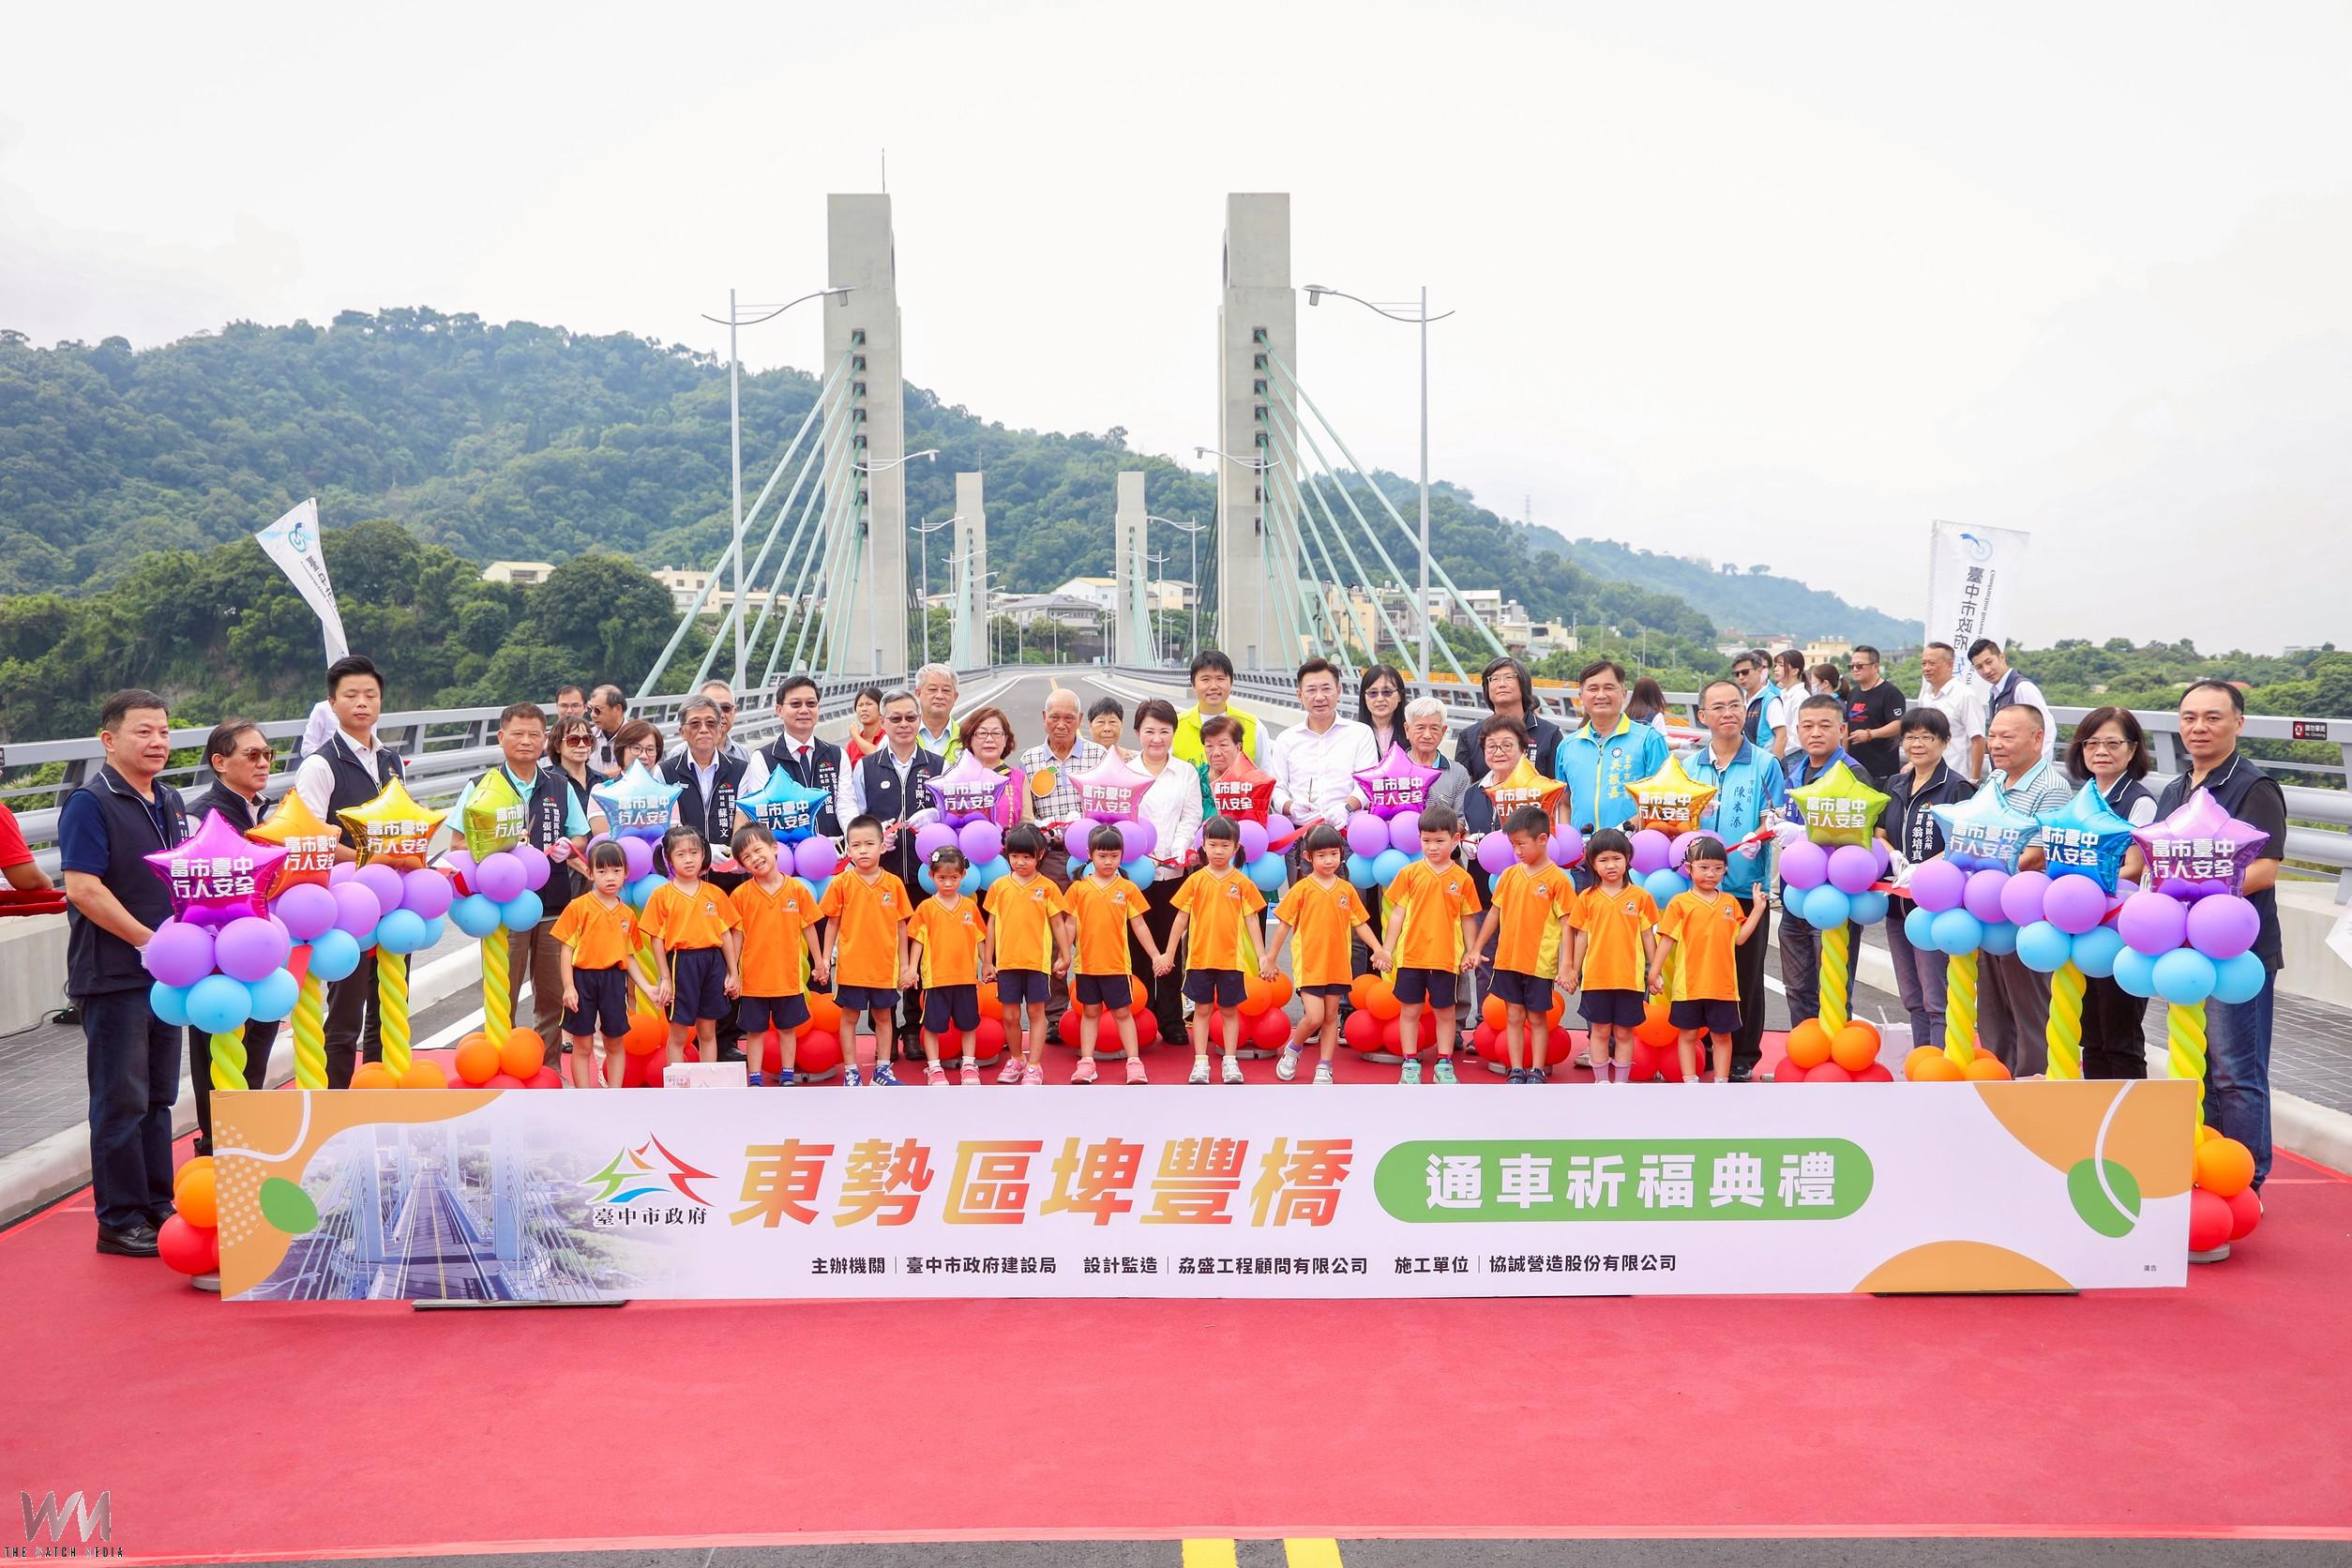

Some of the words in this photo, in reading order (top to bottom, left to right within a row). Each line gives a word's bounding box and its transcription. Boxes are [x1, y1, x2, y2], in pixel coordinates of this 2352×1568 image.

[943, 780, 995, 796] 富市臺中
[1082, 784, 1131, 798] 富市臺中
[1372, 776, 1423, 792] 富市臺中
[618, 795, 669, 809] 富市臺中
[943, 794, 995, 809] 行人安全
[1373, 791, 1423, 806] 行人安全
[1495, 788, 1542, 801] 富市臺中
[1639, 792, 1692, 806] 富市臺中
[756, 800, 809, 816] 富市臺中
[1083, 798, 1131, 814] 行人安全
[1806, 797, 1867, 813] 富市臺中
[618, 809, 669, 825] 行人安全
[1639, 806, 1690, 822] 行人安全
[1806, 813, 1867, 829] 行人安全
[367, 820, 430, 835] 富市臺中
[1952, 820, 2020, 843] 富市臺中
[284, 836, 338, 852] 富市臺中
[368, 837, 428, 854] 行人安全
[1950, 836, 2016, 860] 行人安全
[2152, 838, 2236, 858] 富市臺中
[170, 856, 254, 877] 富市臺中
[2153, 859, 2236, 879] 行人安全
[173, 878, 255, 898] 行人安全
[729, 1137, 1354, 1228] 東勢區埤豐橋
[1425, 1150, 1835, 1211] 通車祈福典禮
[595, 1207, 707, 1227] 臺中市政府
[811, 1257, 885, 1274] 主辦機關
[906, 1257, 1057, 1274] 臺中市政府建設局
[1083, 1257, 1158, 1274] 設計監造
[1178, 1257, 1368, 1274] 劦盛工程顧問有限公司
[1395, 1256, 1470, 1274] 施工單位
[1489, 1254, 1677, 1273] 協誠營造股份有限公司
